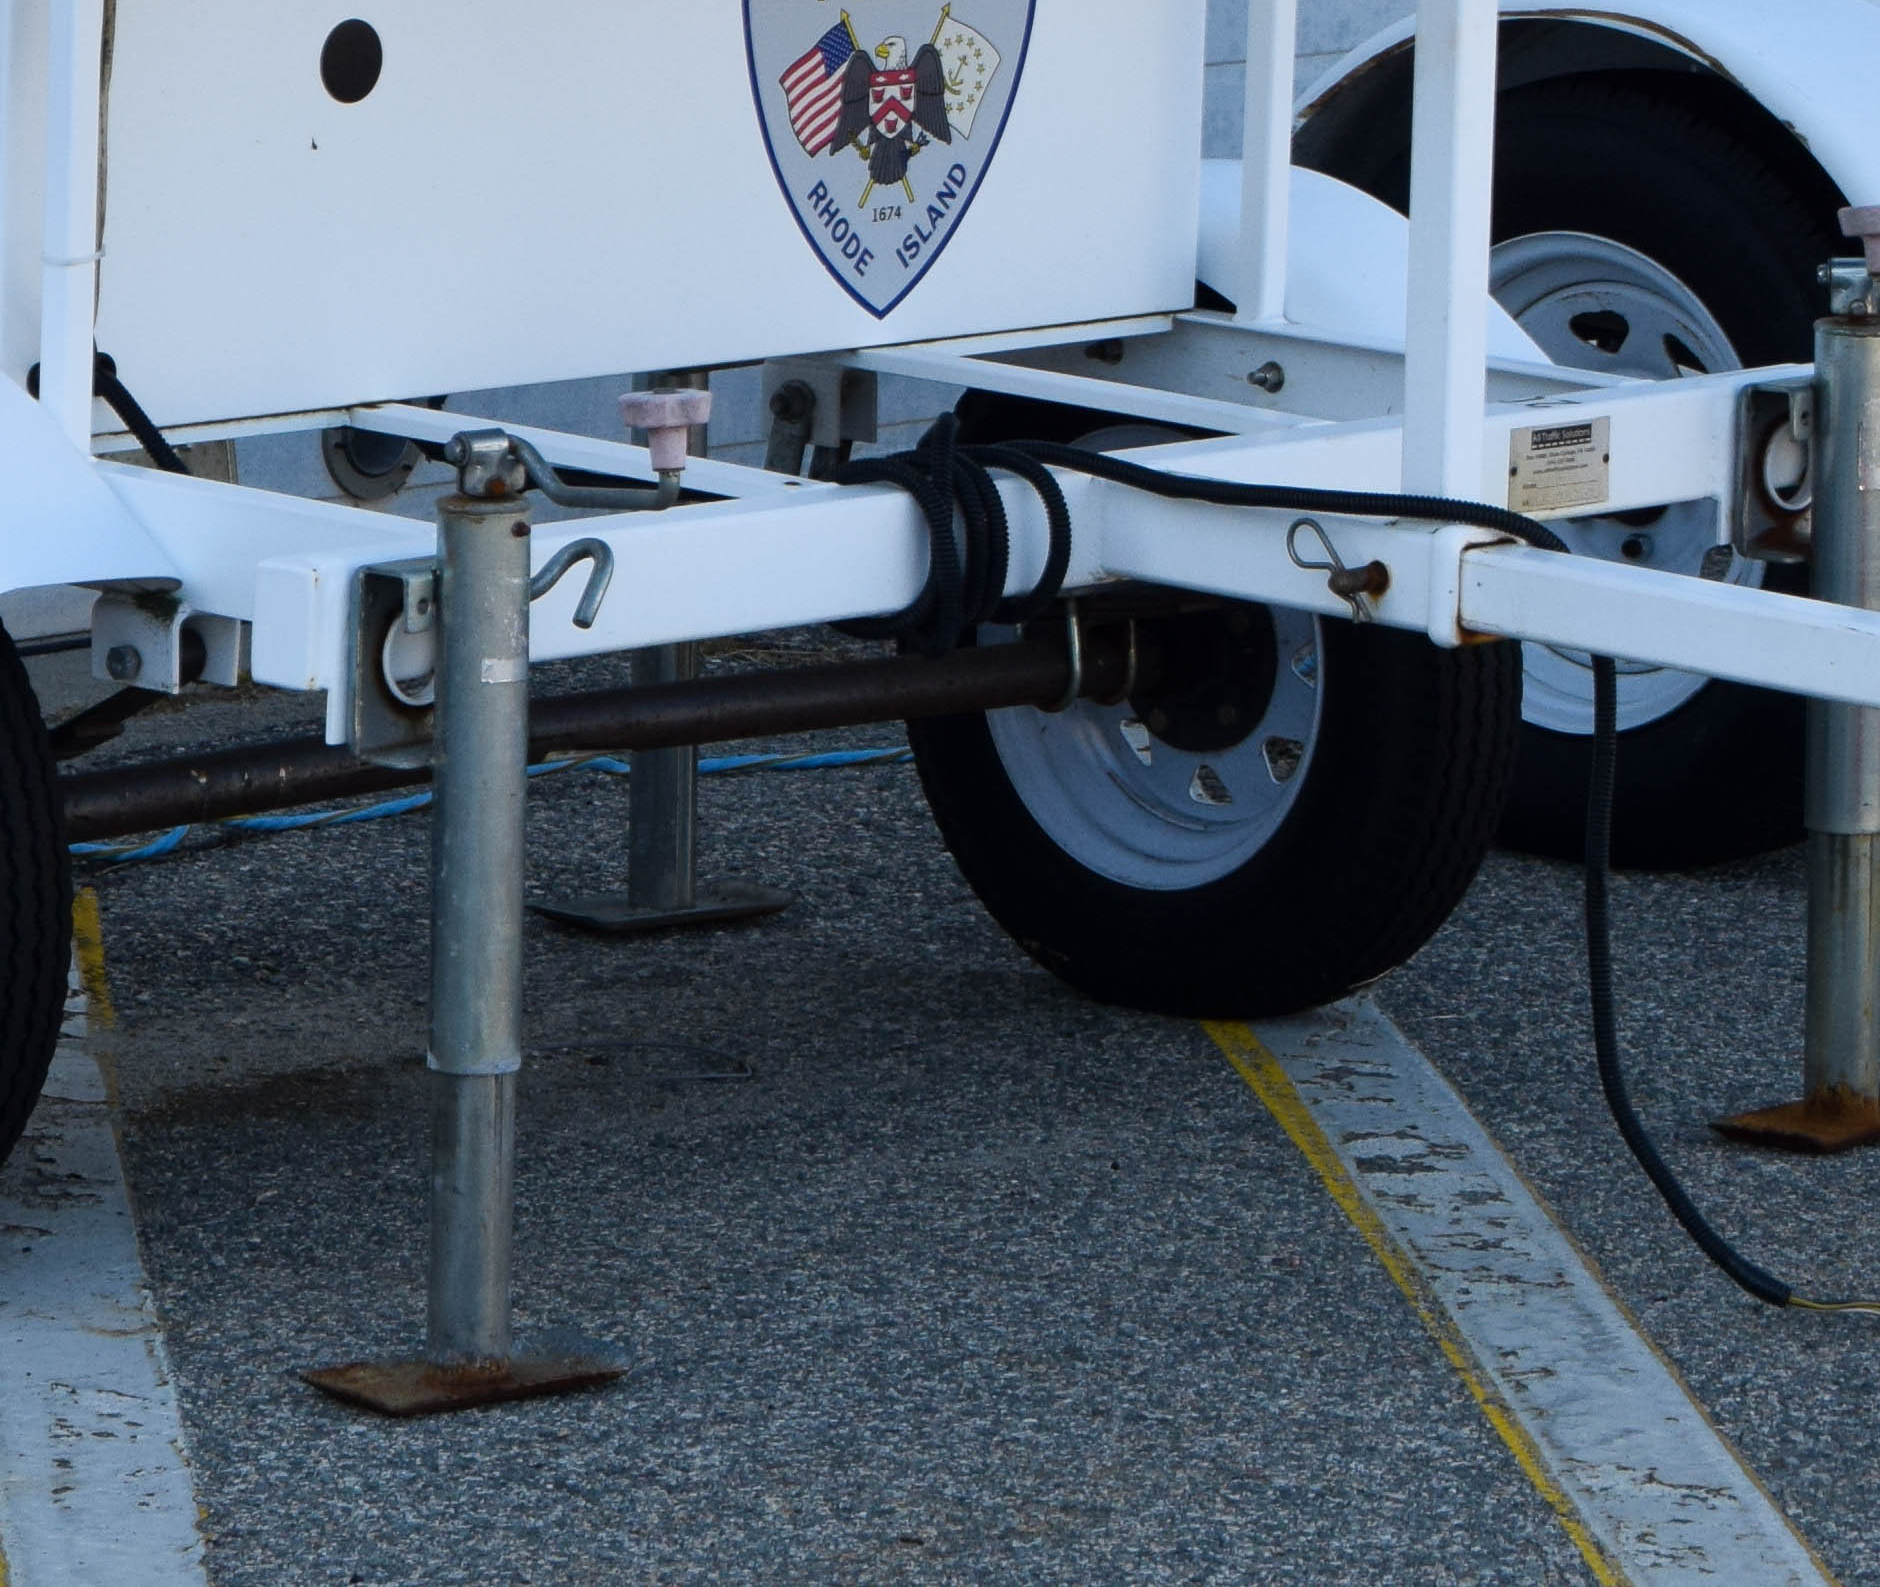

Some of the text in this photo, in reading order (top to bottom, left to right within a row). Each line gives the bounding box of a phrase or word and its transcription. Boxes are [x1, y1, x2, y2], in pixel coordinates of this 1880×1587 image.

[806, 163, 967, 278] RHODE ISLAND
[871, 205, 902, 223] 1674
